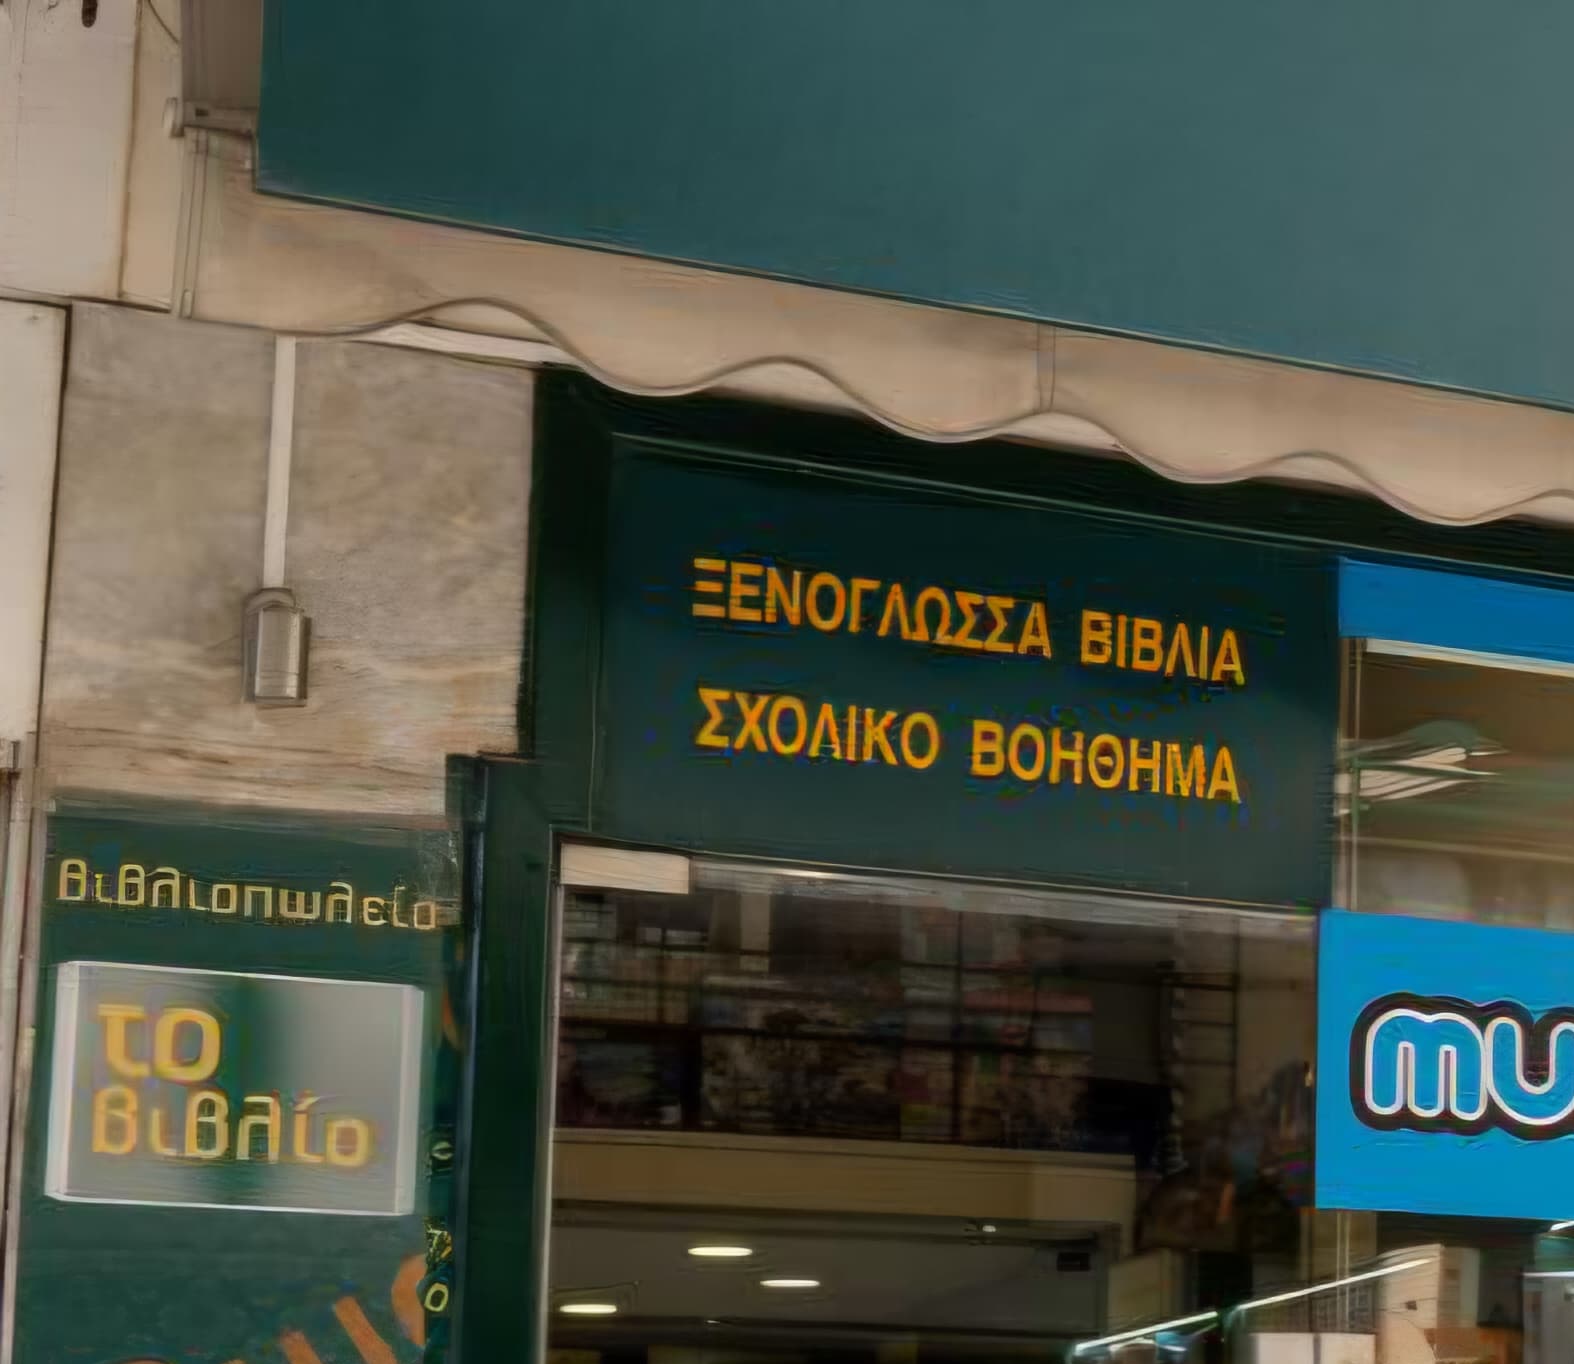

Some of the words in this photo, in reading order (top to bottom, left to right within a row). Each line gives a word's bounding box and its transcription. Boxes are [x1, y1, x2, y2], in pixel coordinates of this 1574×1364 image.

[691, 556, 1053, 660] ΞΕΝΟΓΛΩΣΣΑ
[1079, 608, 1246, 687] ΒΙΒΛΙΑ
[695, 686, 940, 771] ΣΧΟΛΙΚΟ
[968, 718, 1243, 804] ΒΟΗΘΗΜΑ
[56, 857, 438, 931] βιβλιοπωλείο
